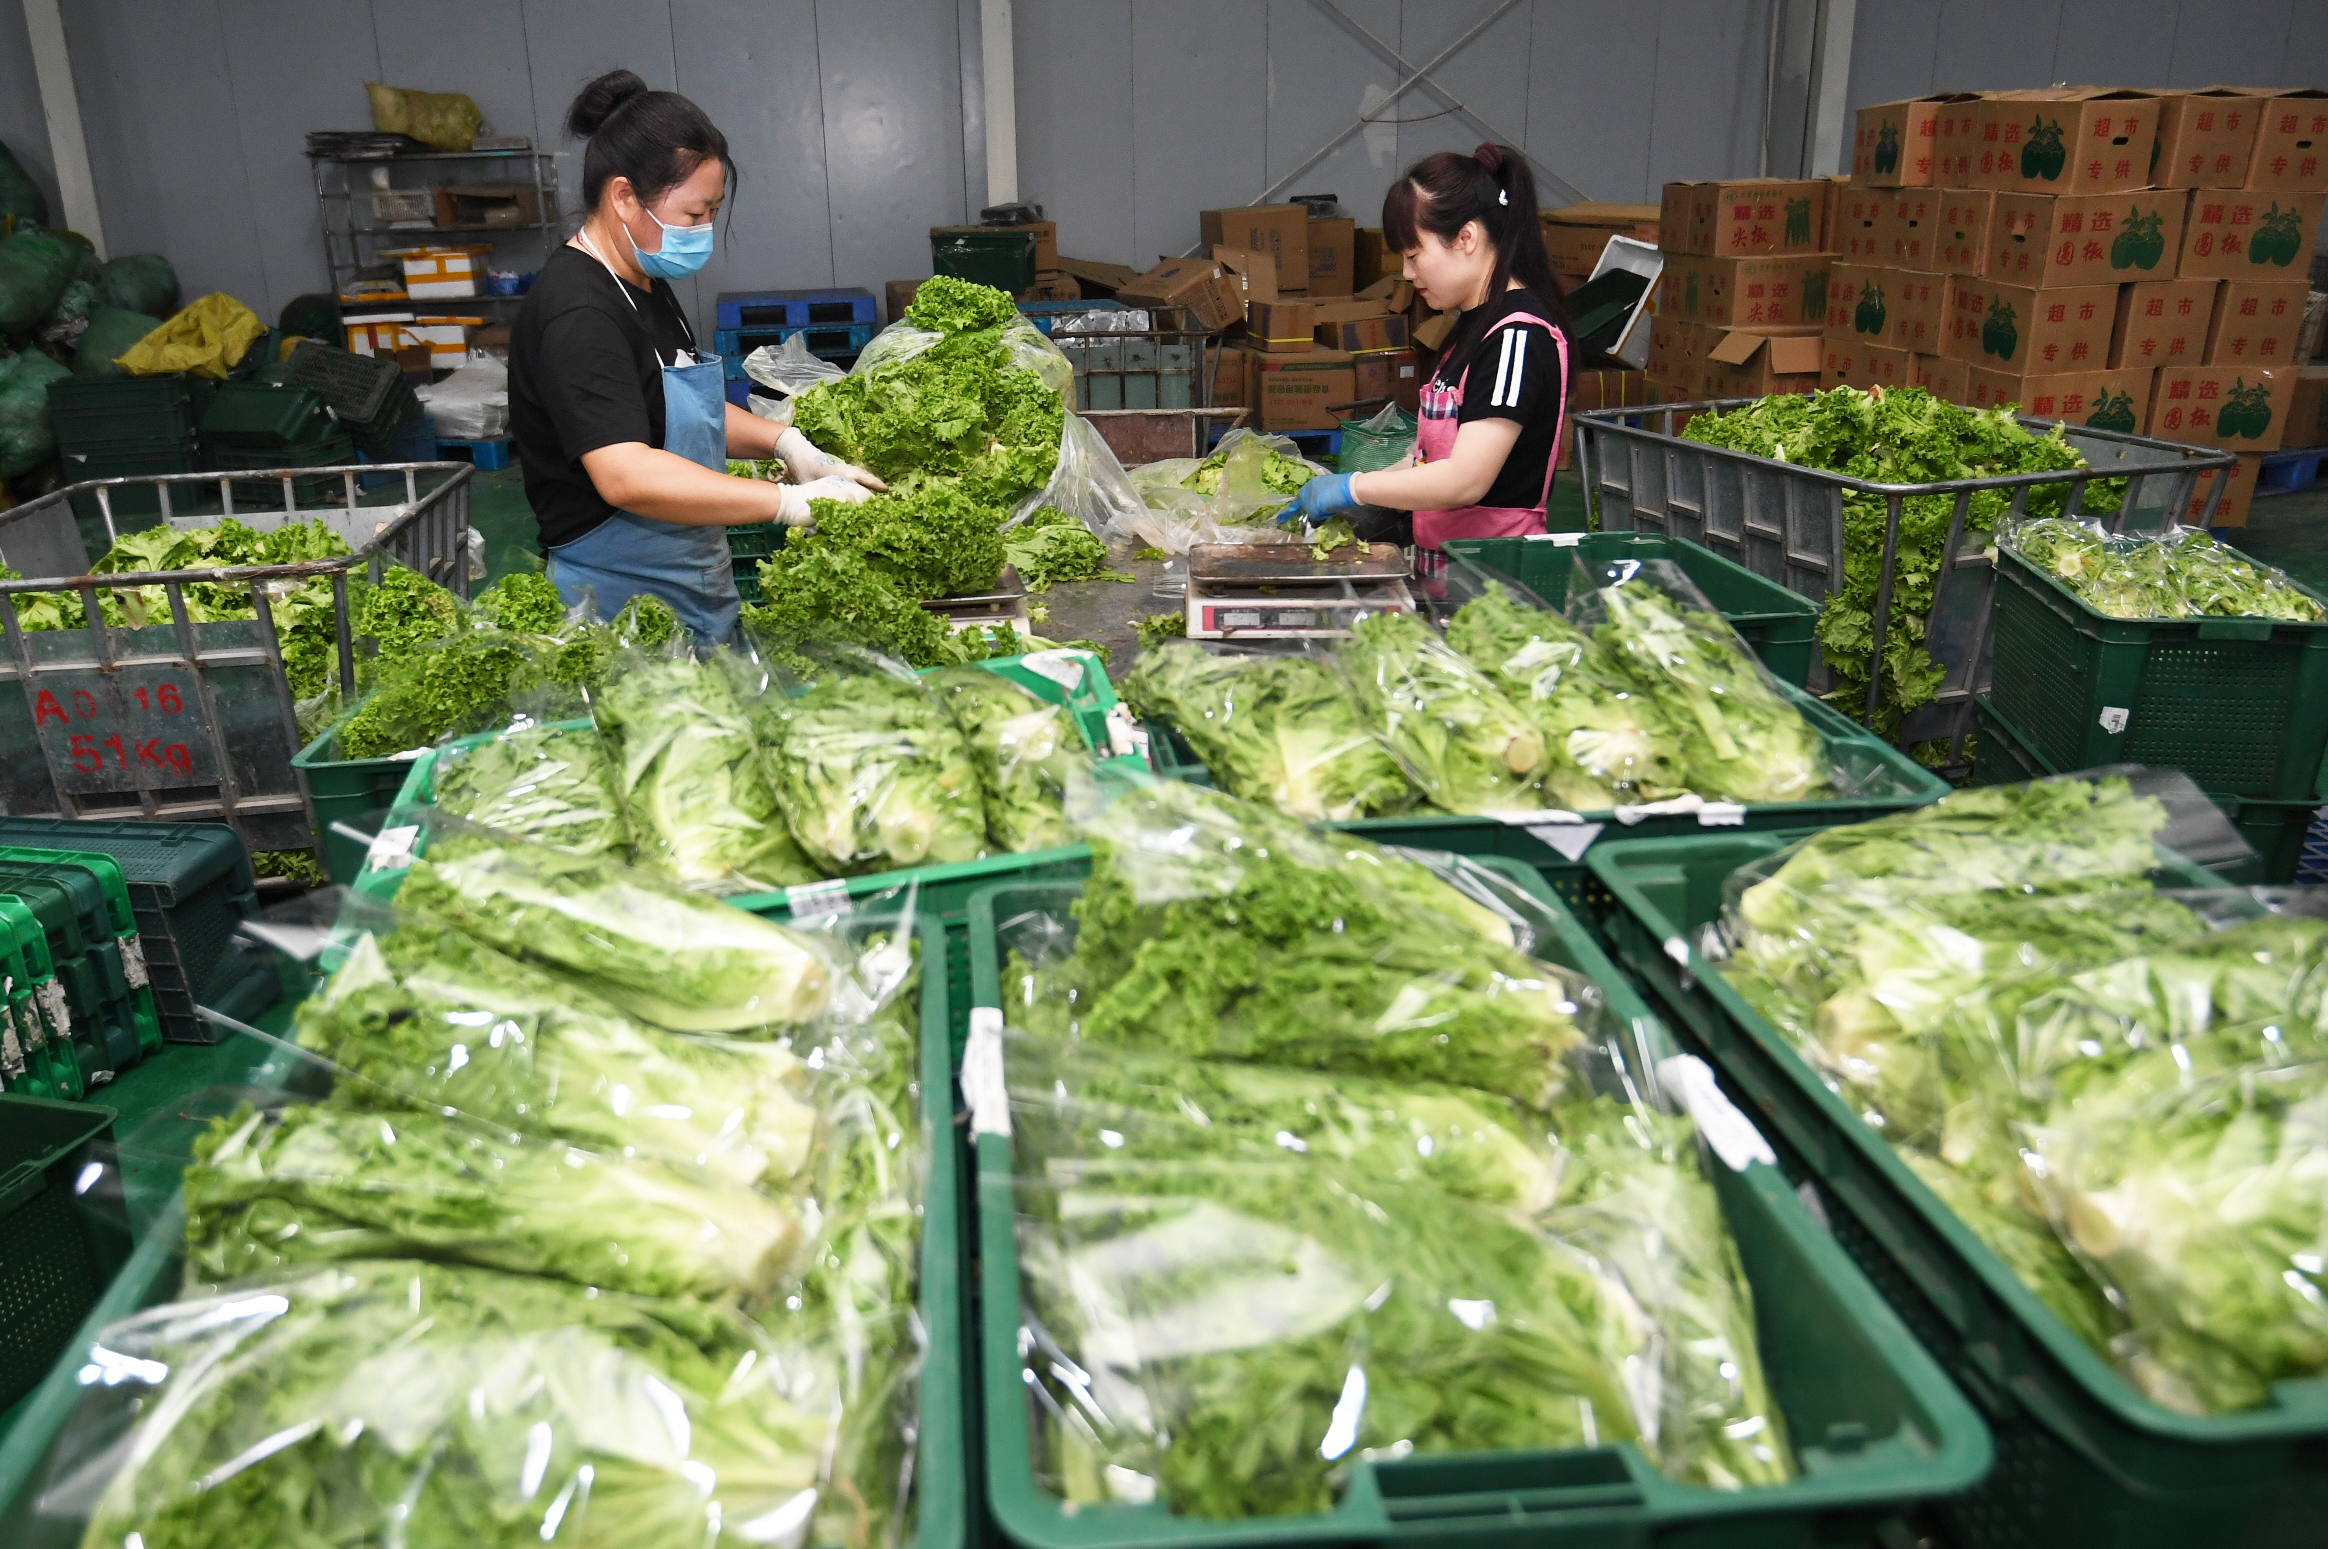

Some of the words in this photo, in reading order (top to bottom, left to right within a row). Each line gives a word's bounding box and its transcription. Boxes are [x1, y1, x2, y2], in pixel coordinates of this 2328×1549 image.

[2093, 116, 2140, 137] 超市
[2196, 111, 2241, 131] 超市
[2279, 114, 2328, 134] 超市
[1984, 121, 2021, 143] 精选
[2088, 160, 2130, 180] 专供
[2189, 154, 2231, 174] 专供
[2270, 156, 2317, 176] 专供
[2060, 211, 2113, 233] 精选
[2200, 204, 2253, 225] 精选
[2047, 302, 2096, 322] 超市
[2145, 297, 2193, 316] 超市
[2239, 297, 2287, 316] 超市
[2042, 342, 2089, 362] 专供
[2140, 337, 2186, 356] 专供
[2231, 336, 2278, 356] 专供
[2169, 380, 2220, 400] 精选
[2031, 394, 2084, 416] 精选
